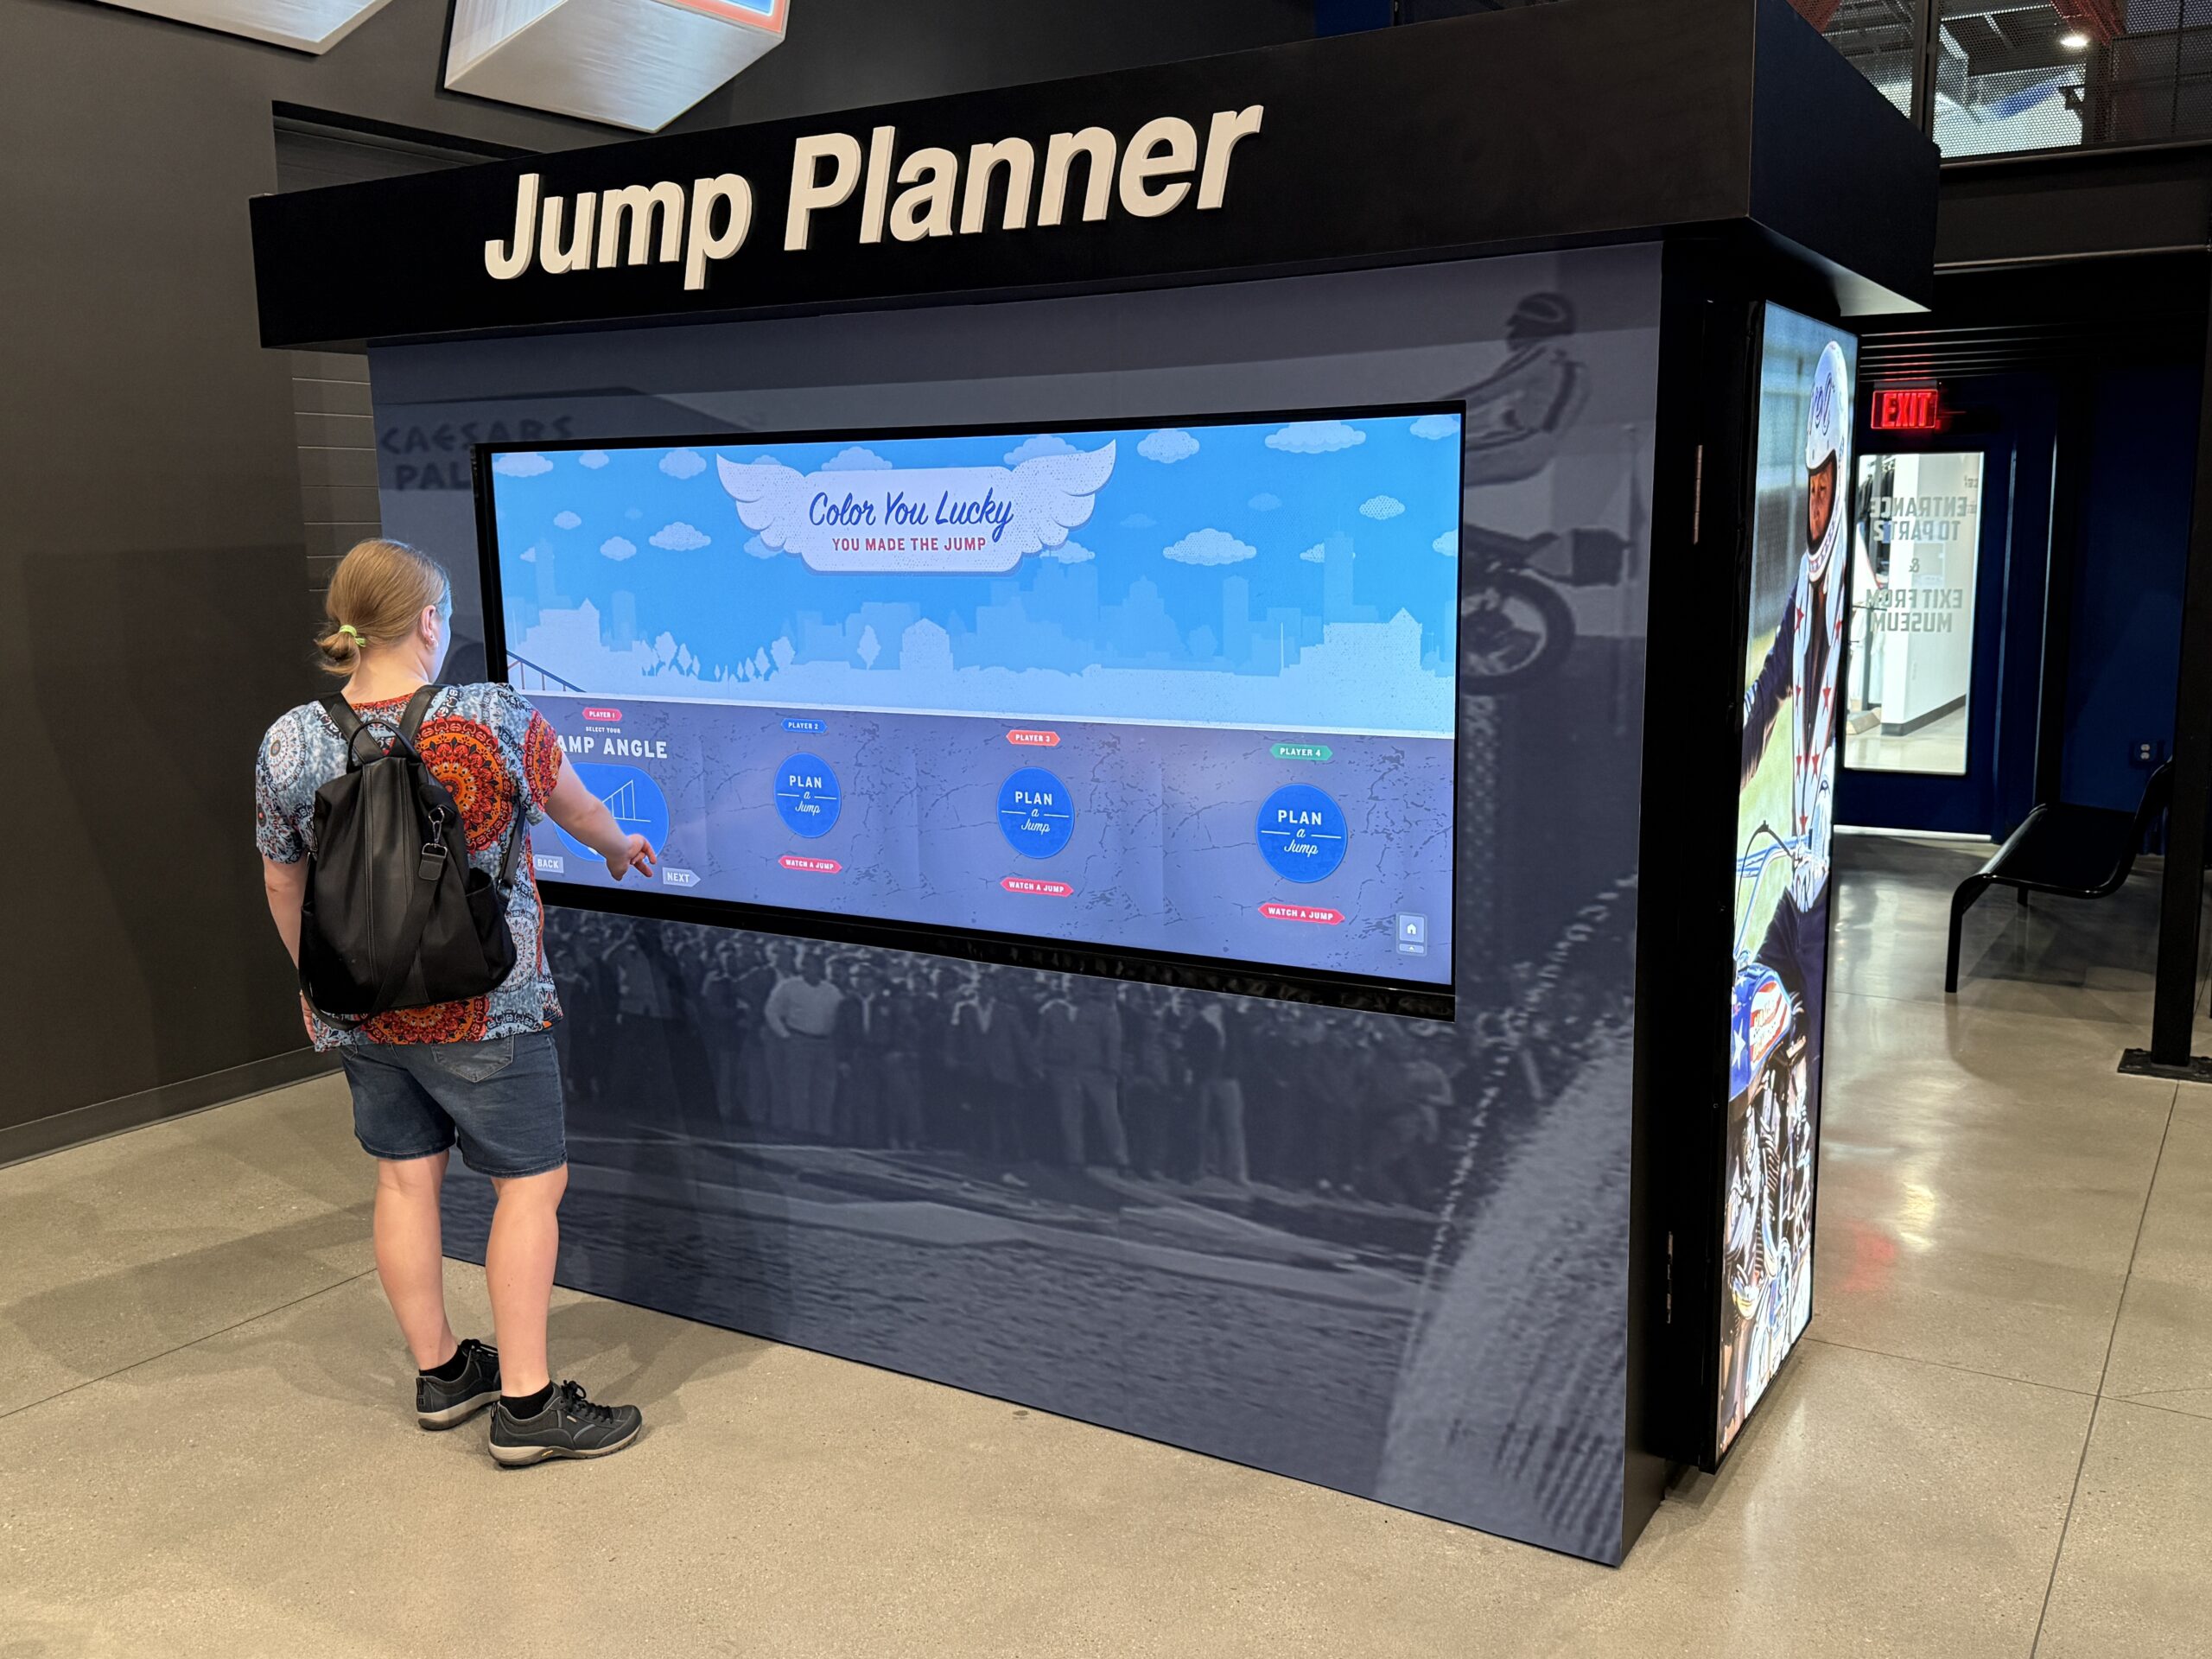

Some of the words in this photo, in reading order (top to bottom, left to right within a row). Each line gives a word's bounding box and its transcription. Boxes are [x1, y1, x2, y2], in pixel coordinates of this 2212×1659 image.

[483, 172, 753, 290] Jump
[783, 104, 1265, 251] Planner
[1881, 392, 1932, 427] EXIT
[380, 415, 574, 455] CAESARS
[396, 461, 472, 491] PAL
[809, 492, 877, 526] Color
[885, 490, 930, 526] You
[935, 487, 1014, 543] Lucky
[832, 537, 861, 552] YOU
[866, 537, 906, 551] MADE
[911, 537, 938, 551] THE
[944, 537, 987, 551] JUMP
[788, 721, 813, 730] PLAYER
[1015, 734, 1043, 743] PLAYER
[557, 734, 594, 753] AMP
[603, 738, 668, 759] ANGLE
[1280, 747, 1313, 757] PLAYER
[1315, 749, 1321, 758] 4
[789, 775, 823, 788] PLAN
[804, 791, 811, 800] a
[1014, 791, 1053, 805] PLAN
[795, 801, 821, 816] Jump
[1031, 808, 1039, 817] a
[1278, 810, 1322, 825] PLAN
[1020, 818, 1051, 835] Jump
[1296, 828, 1306, 838] a
[1284, 839, 1319, 857] Jump
[537, 859, 559, 869] BACK
[785, 859, 808, 868] WATCH
[816, 861, 835, 870] JUMP
[667, 872, 690, 883] NEXT
[1008, 880, 1033, 890] WATCH
[1043, 884, 1065, 893] JUMP
[1268, 906, 1298, 918] WATCH
[1300, 909, 1306, 918] A
[1308, 910, 1333, 921] JUMP
